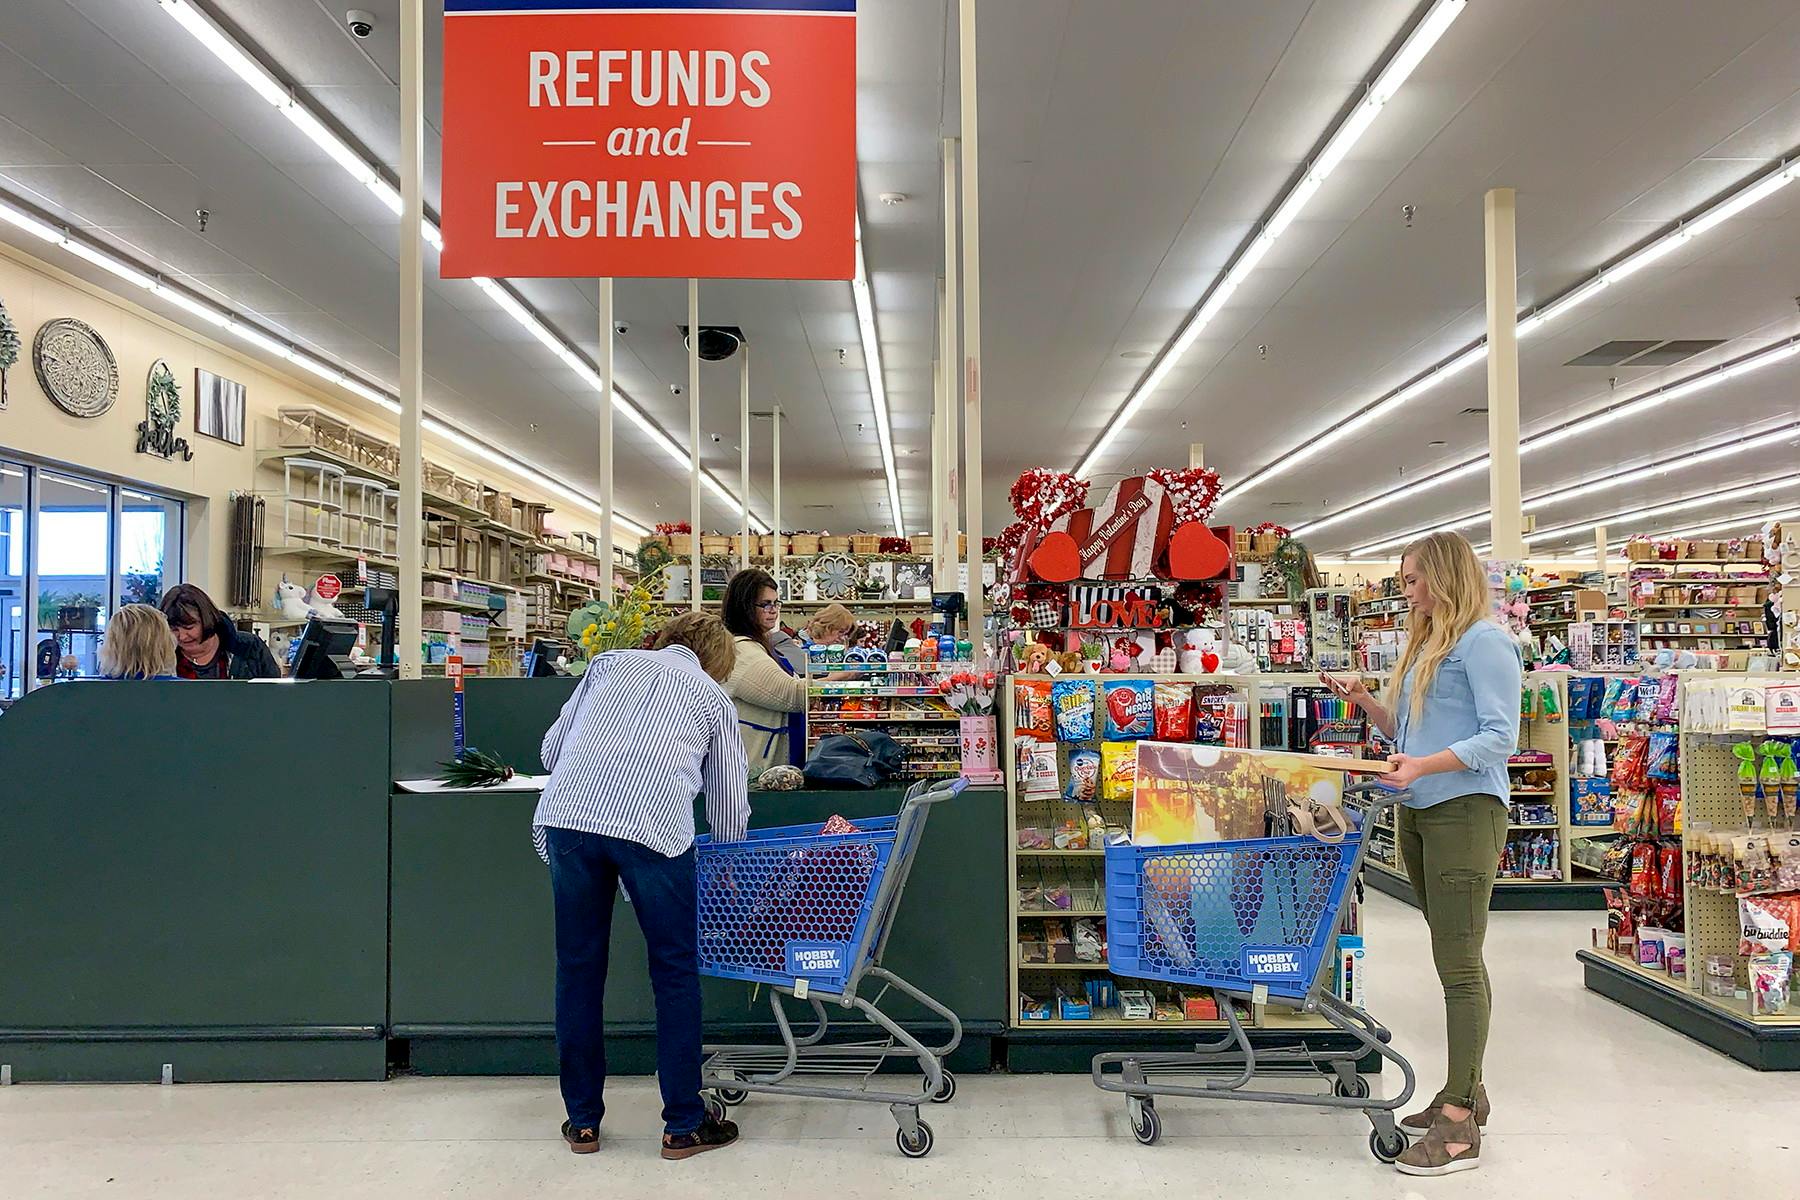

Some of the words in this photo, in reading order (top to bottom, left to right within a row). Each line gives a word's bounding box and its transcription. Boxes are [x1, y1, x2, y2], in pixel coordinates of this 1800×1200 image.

[529, 50, 771, 107] REFUNDS
[606, 117, 692, 157] and
[495, 180, 803, 239] EXCHANGES
[1078, 538, 1106, 561] Happy
[1098, 509, 1133, 541] Valentine's
[1128, 497, 1148, 513] Day
[1070, 599, 1157, 628] LOVE
[1135, 692, 1152, 704] AIR
[1125, 702, 1153, 717] HEADS
[795, 950, 836, 962] HOBBY
[1249, 953, 1294, 965] HOBBY
[802, 959, 841, 970] LOBBY
[1257, 961, 1299, 973] LOBBY
